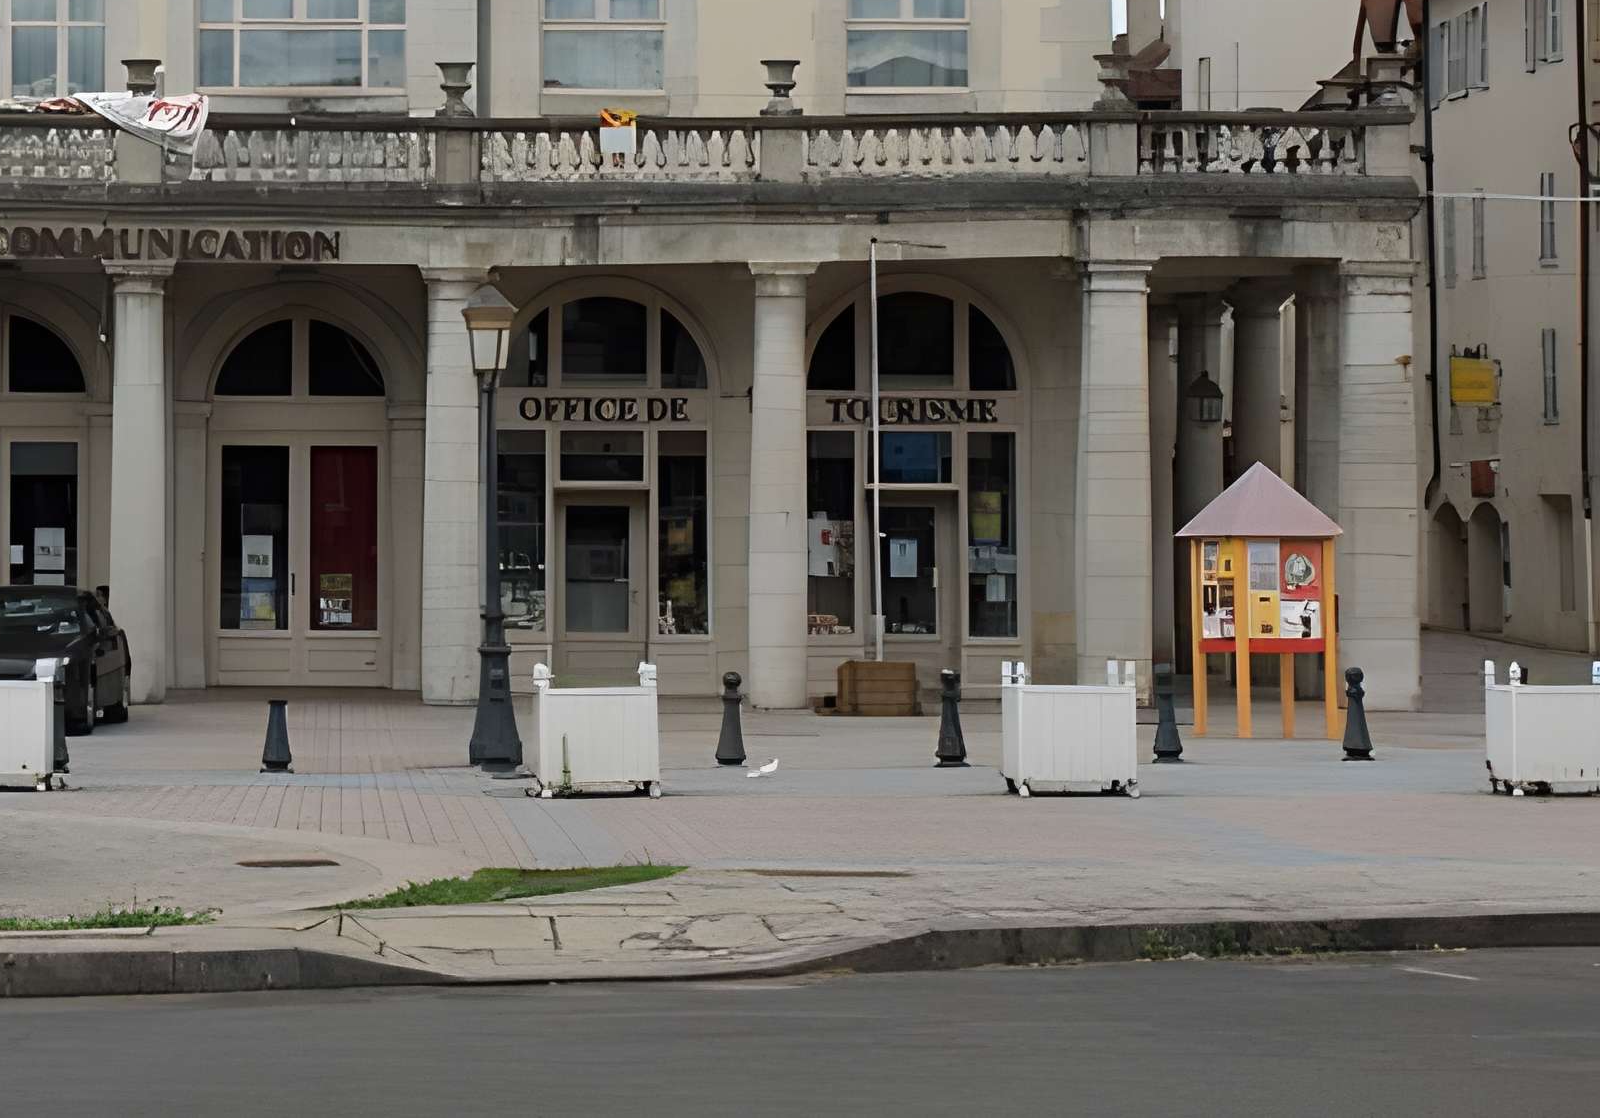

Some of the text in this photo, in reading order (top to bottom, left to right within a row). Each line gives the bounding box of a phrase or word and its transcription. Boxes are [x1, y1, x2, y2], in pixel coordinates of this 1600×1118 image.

[518, 396, 691, 422] OFFICE DE
[825, 397, 998, 425] TOURISME
